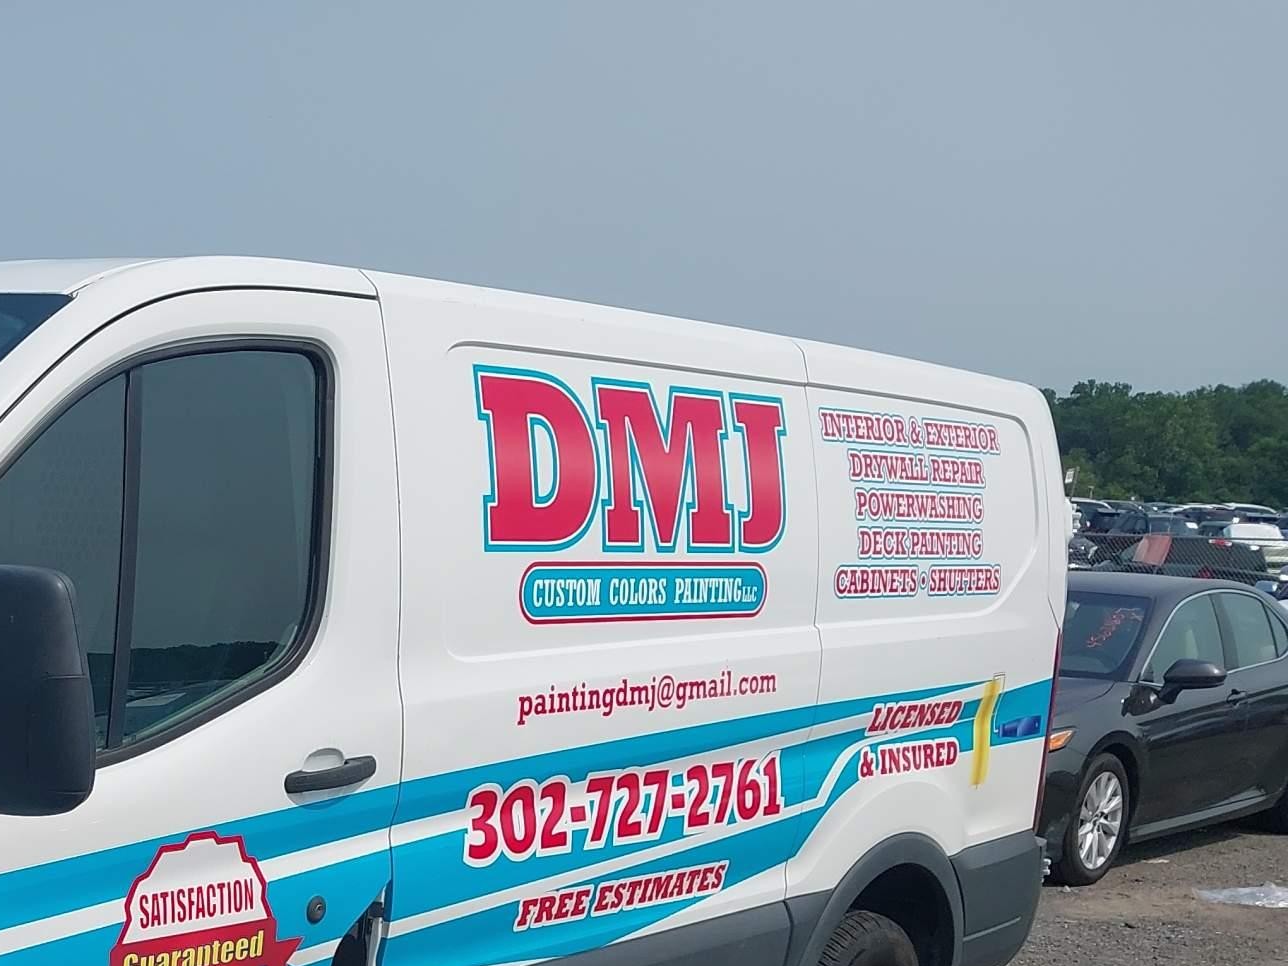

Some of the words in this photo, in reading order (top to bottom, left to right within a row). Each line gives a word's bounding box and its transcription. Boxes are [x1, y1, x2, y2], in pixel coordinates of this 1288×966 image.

[820, 410, 908, 444] INTERIOR
[910, 416, 922, 445] &
[923, 421, 1000, 452] EXTERIOR
[472, 364, 787, 554] DMJ
[848, 452, 930, 482] DRYWALL
[930, 457, 985, 485] REPAIR
[856, 491, 984, 520] POWERWASHING
[859, 530, 907, 556] DECK
[910, 531, 982, 557] PAINTING
[532, 578, 601, 607] CUSTOM
[609, 577, 667, 605] COLORS
[836, 568, 917, 595] CABINETS
[929, 567, 1000, 593] SHUTTERS
[516, 670, 778, 726] paintingdmj@gmail.com
[867, 700, 963, 733] LICENSED
[860, 750, 874, 777] &
[880, 740, 958, 775] INSURED
[467, 756, 782, 860] 302-727-2761
[139, 877, 255, 929] SATISFACTION
[516, 889, 591, 928] FREE
[593, 864, 727, 912] ESTIMATES
